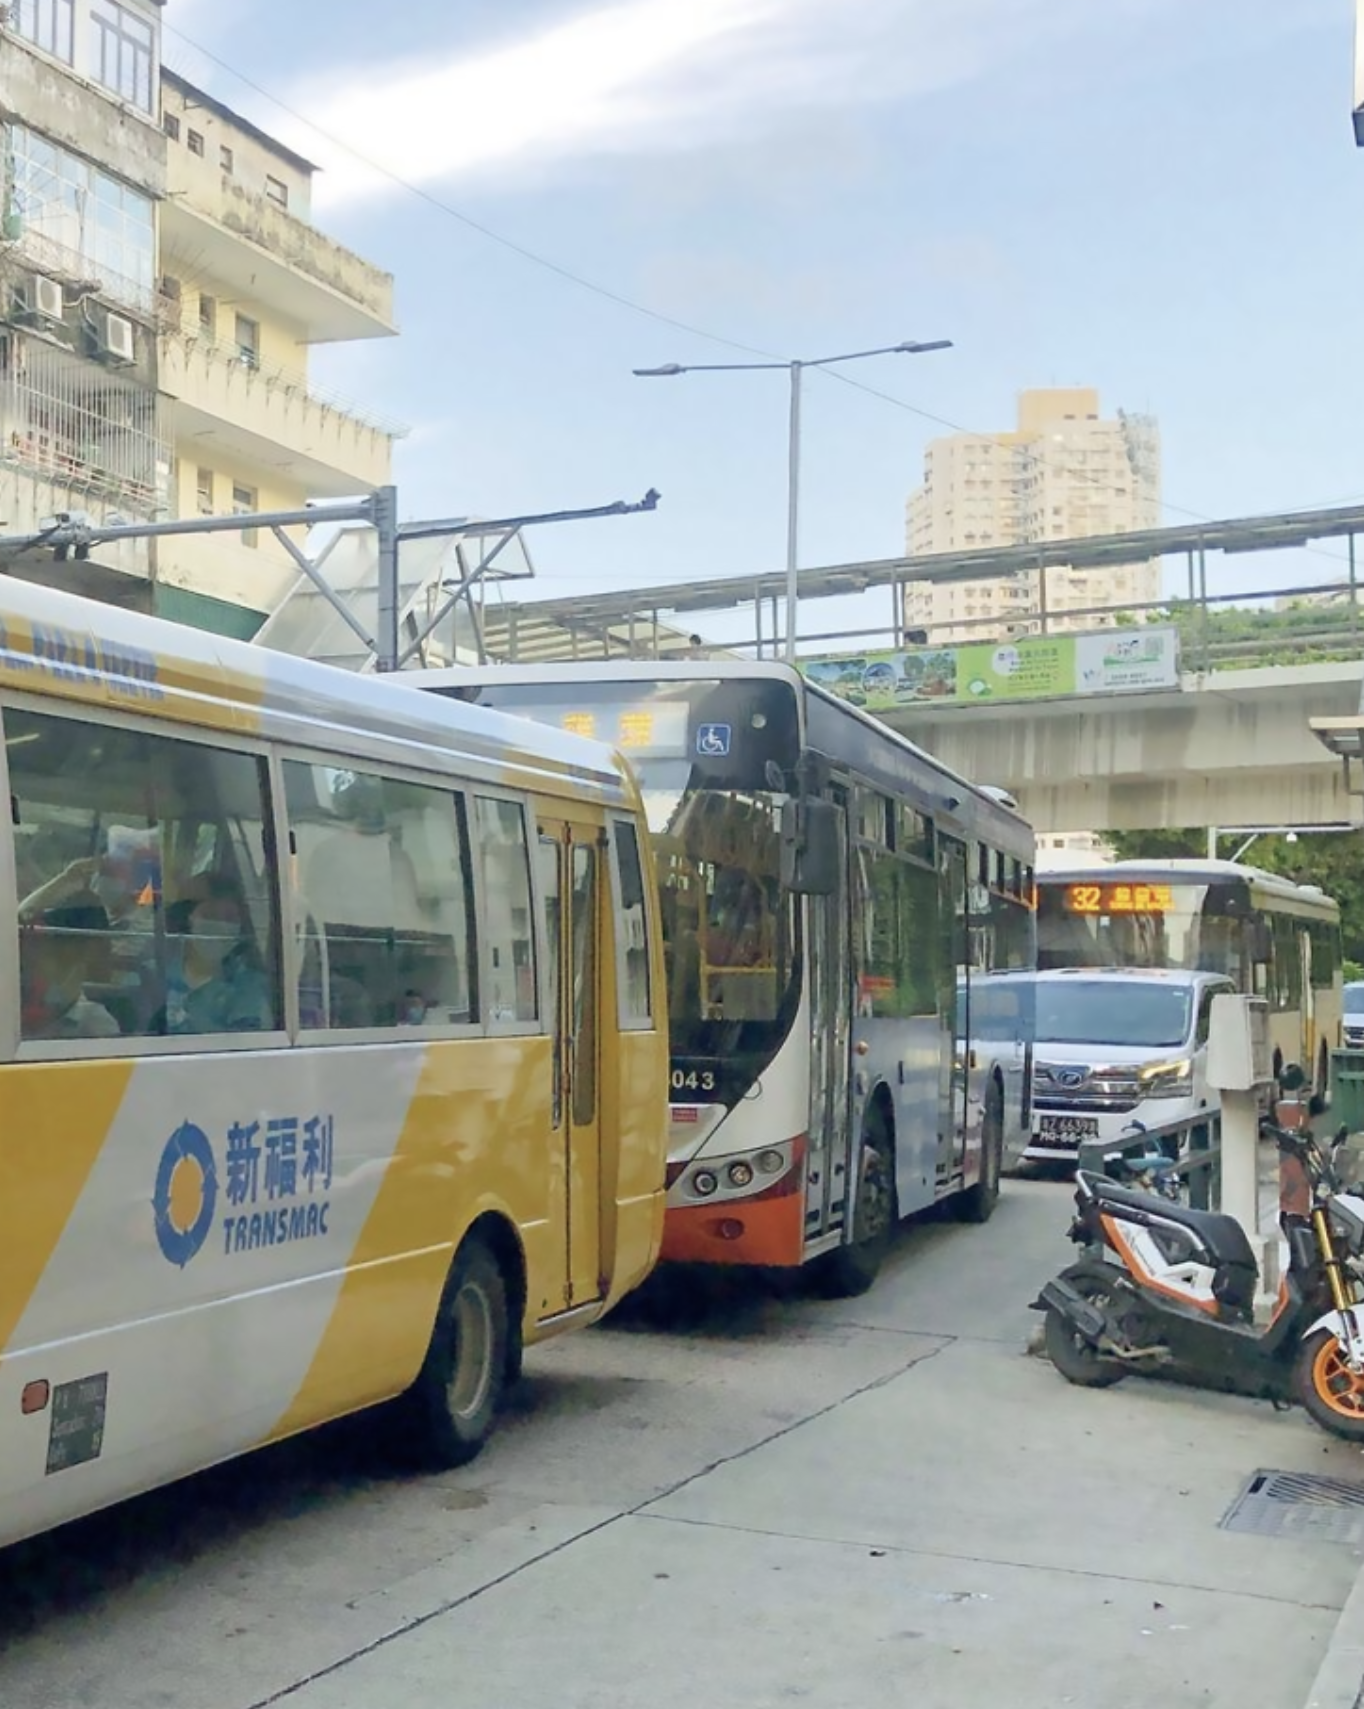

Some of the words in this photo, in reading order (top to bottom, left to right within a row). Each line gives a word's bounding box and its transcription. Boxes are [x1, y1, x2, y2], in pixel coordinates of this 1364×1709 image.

[1073, 886, 1101, 911] 32
[225, 1114, 333, 1206] 新福利
[223, 1202, 330, 1255] TRANSMAC
